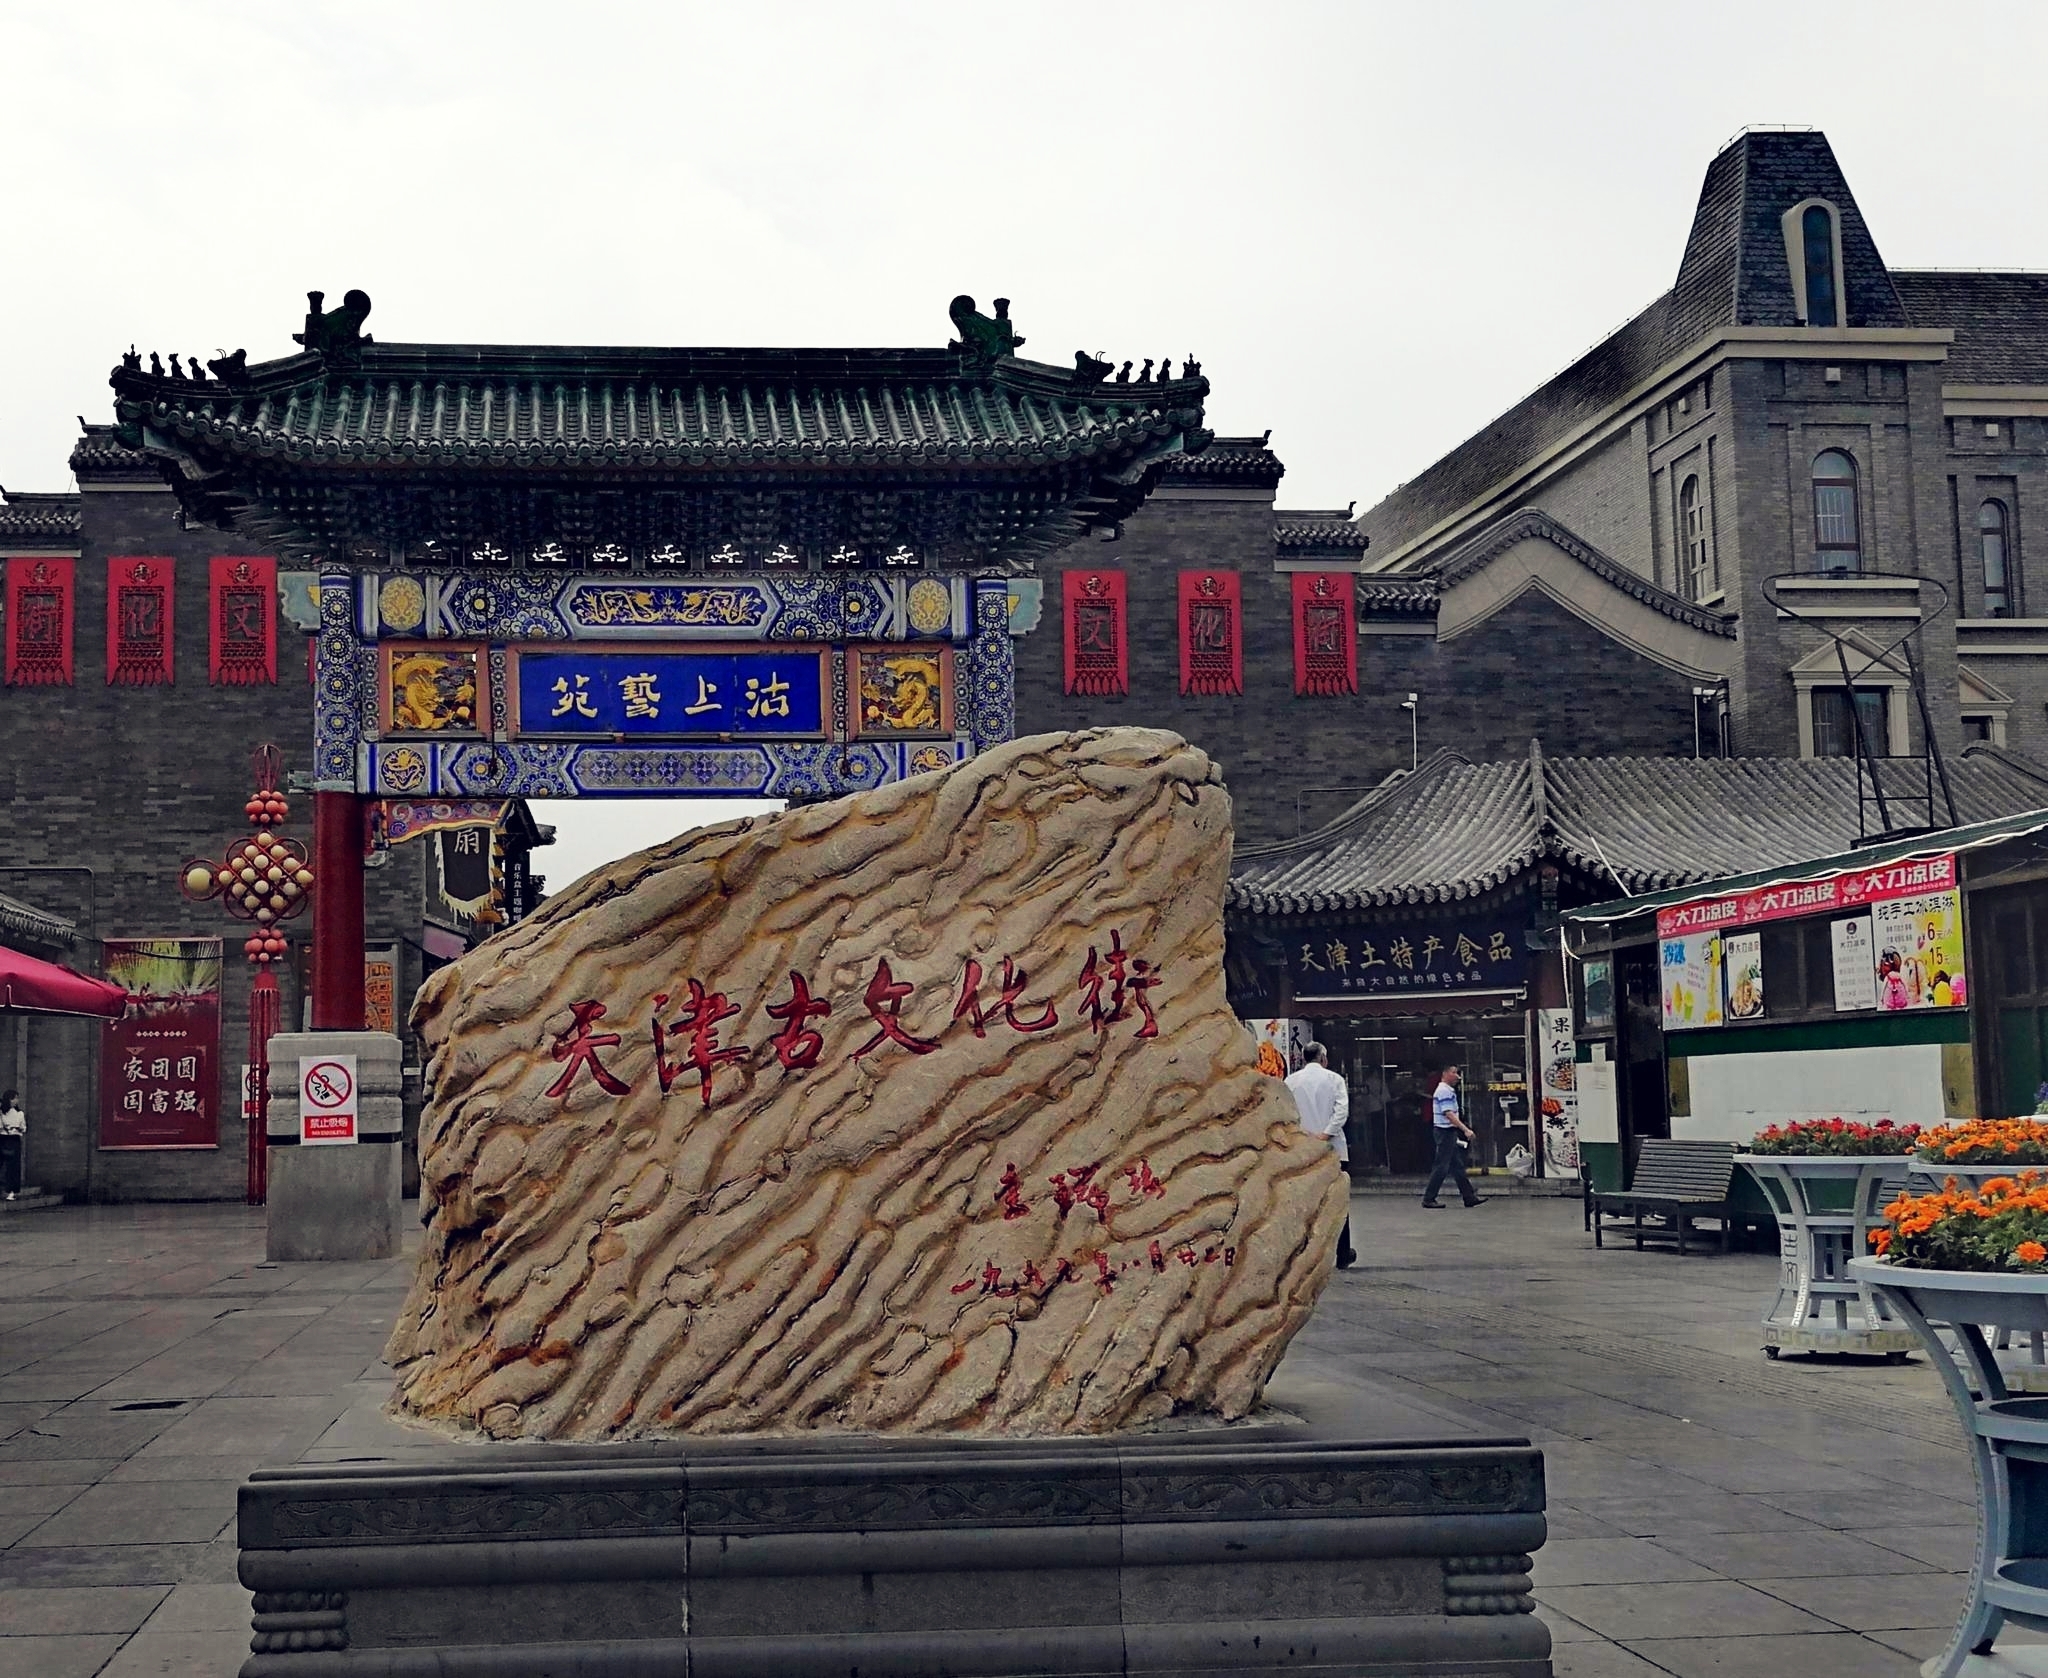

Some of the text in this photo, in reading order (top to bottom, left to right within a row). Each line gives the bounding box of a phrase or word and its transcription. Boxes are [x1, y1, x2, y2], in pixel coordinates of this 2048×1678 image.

[454, 829, 480, 855] 扇
[1865, 859, 1951, 893] 大刀凉皮
[1761, 880, 1836, 912] 大刀凉皮
[1675, 900, 1738, 926] 大刀凉皮
[1300, 931, 1513, 976] 天津土特产食品
[545, 929, 1163, 1107] 天津古文化街
[123, 1056, 198, 1082] 家团圆
[123, 1089, 199, 1114] 国富强
